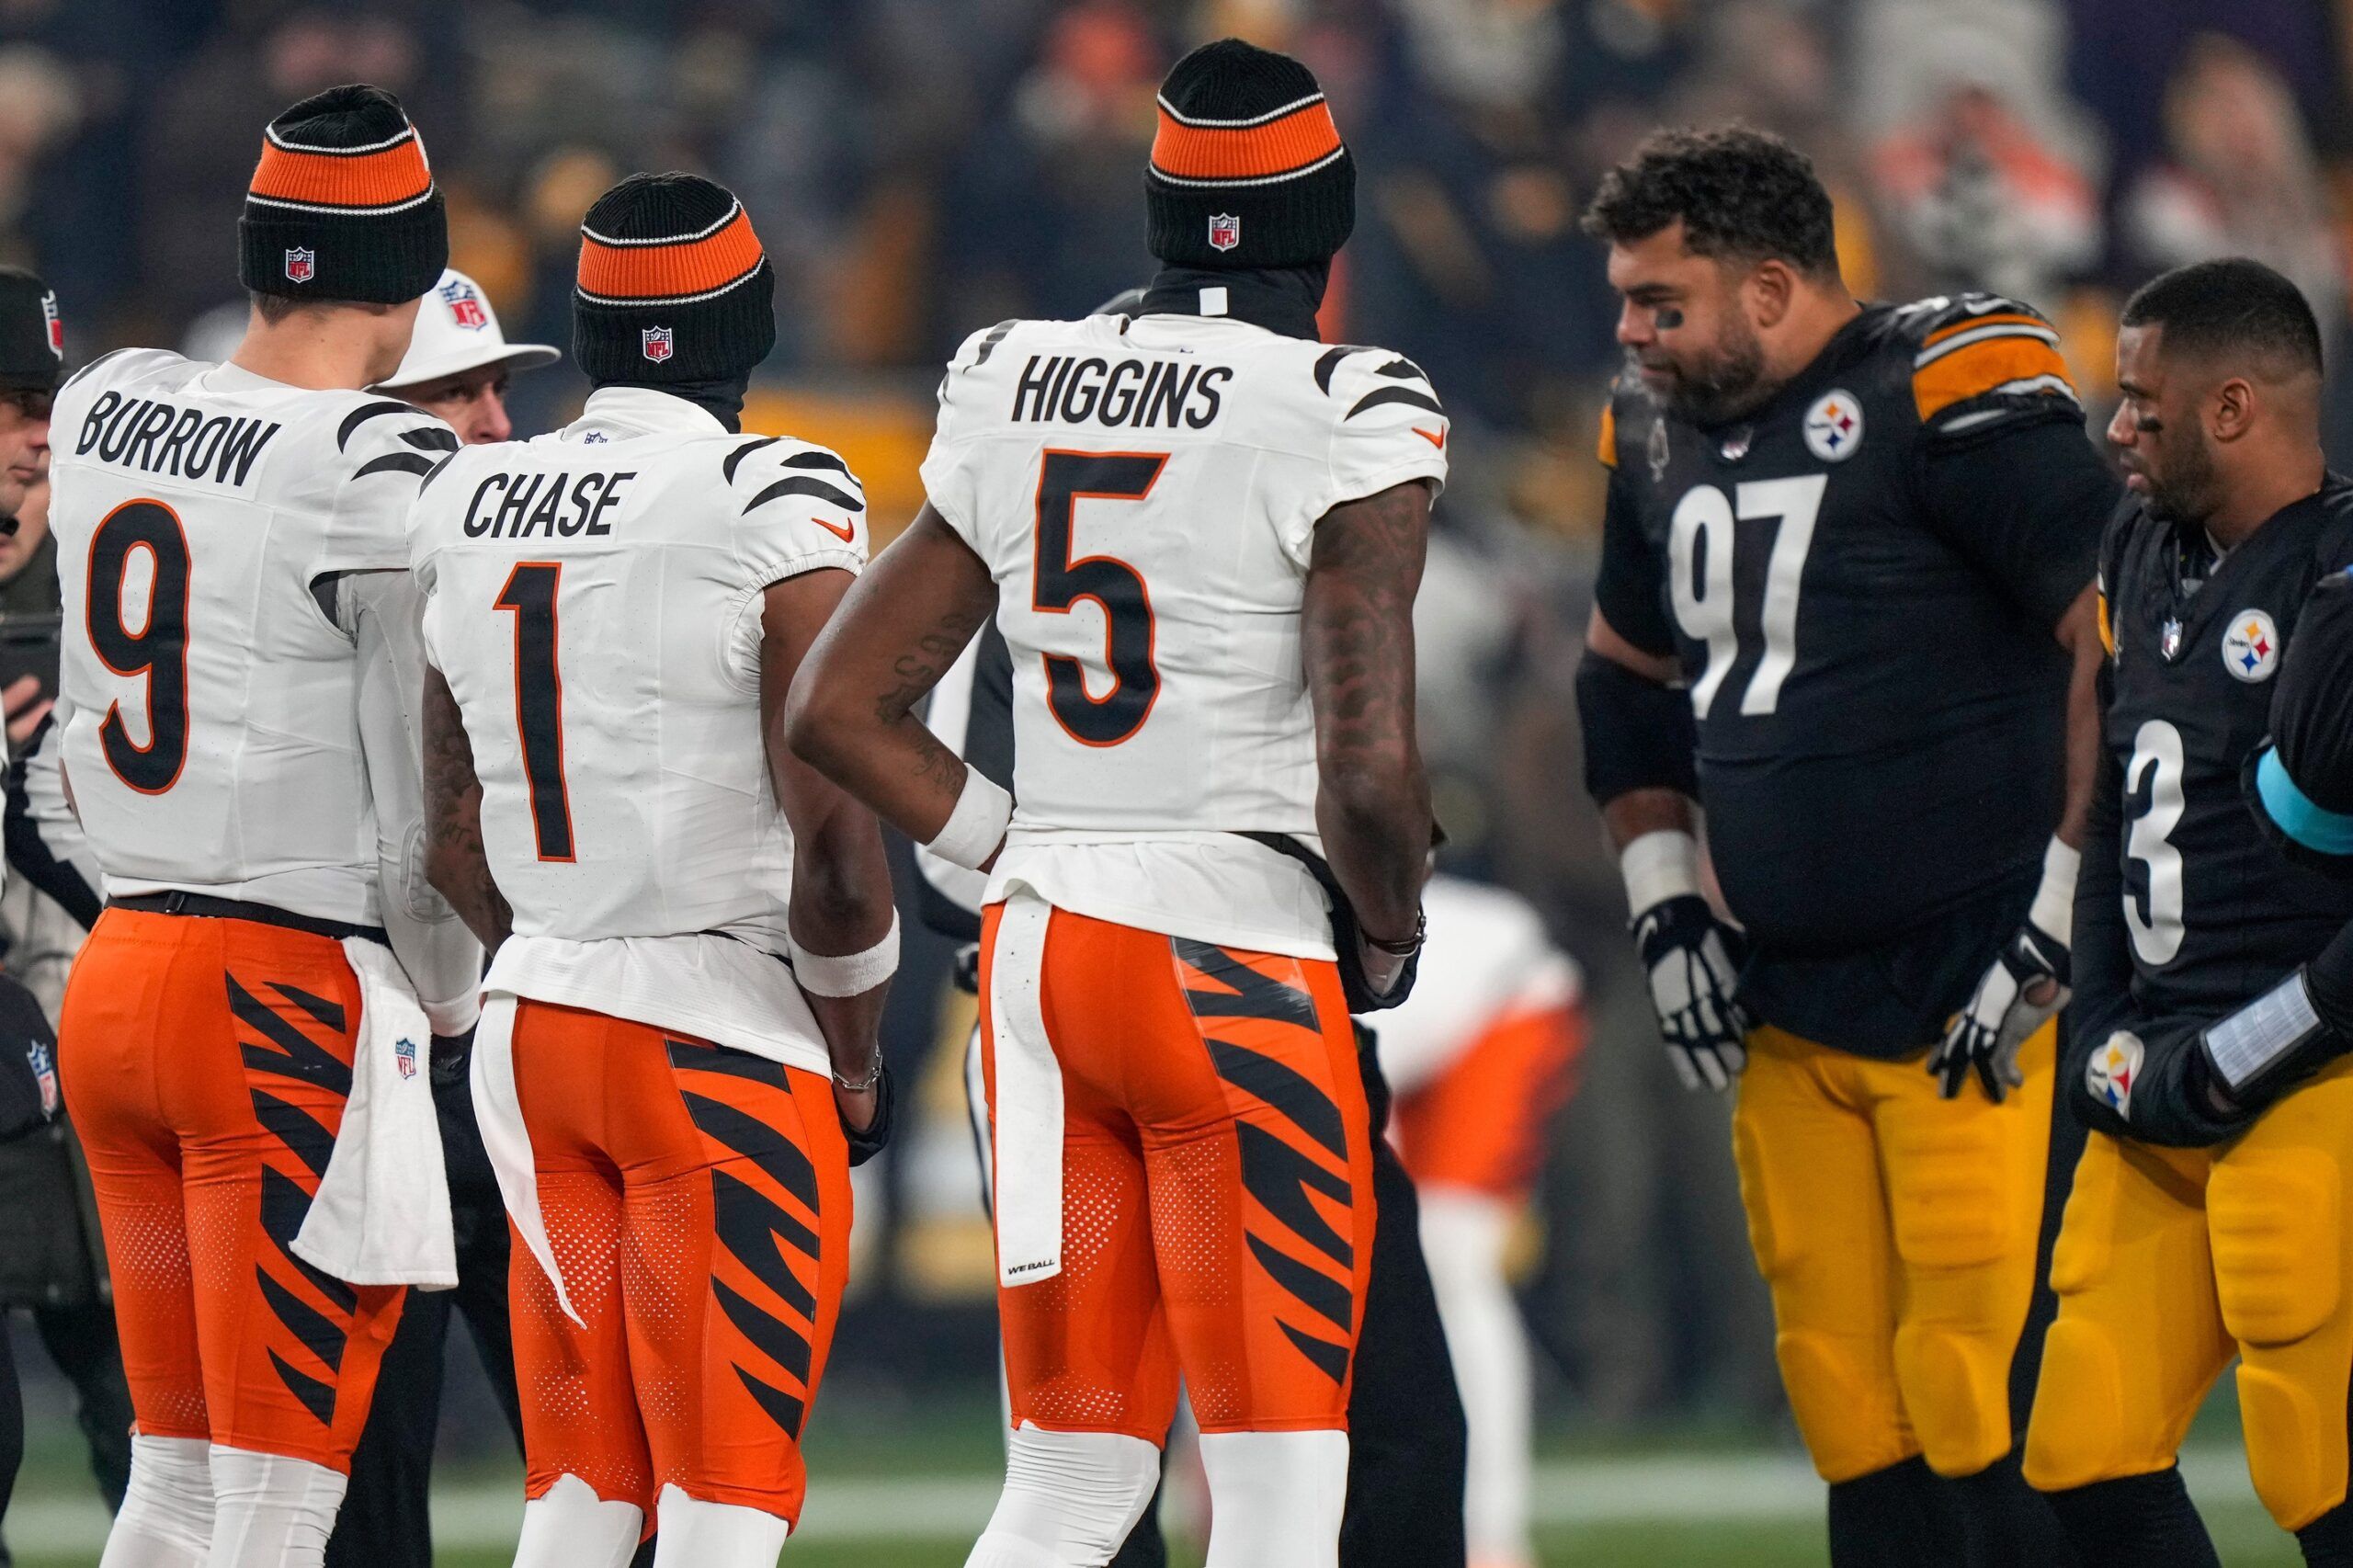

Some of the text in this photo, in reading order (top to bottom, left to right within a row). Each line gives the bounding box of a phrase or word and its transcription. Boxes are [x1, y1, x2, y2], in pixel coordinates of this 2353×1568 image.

[74, 391, 282, 487] BURROW
[463, 472, 638, 539] CHASE
[1012, 356, 1233, 429] HIGGINS
[85, 497, 192, 796] 9
[492, 561, 577, 864] 1
[1032, 449, 1171, 748] 5
[1669, 474, 1828, 719] 97
[2123, 720, 2186, 965] 3
[1008, 1259, 1055, 1275] WE BALL
